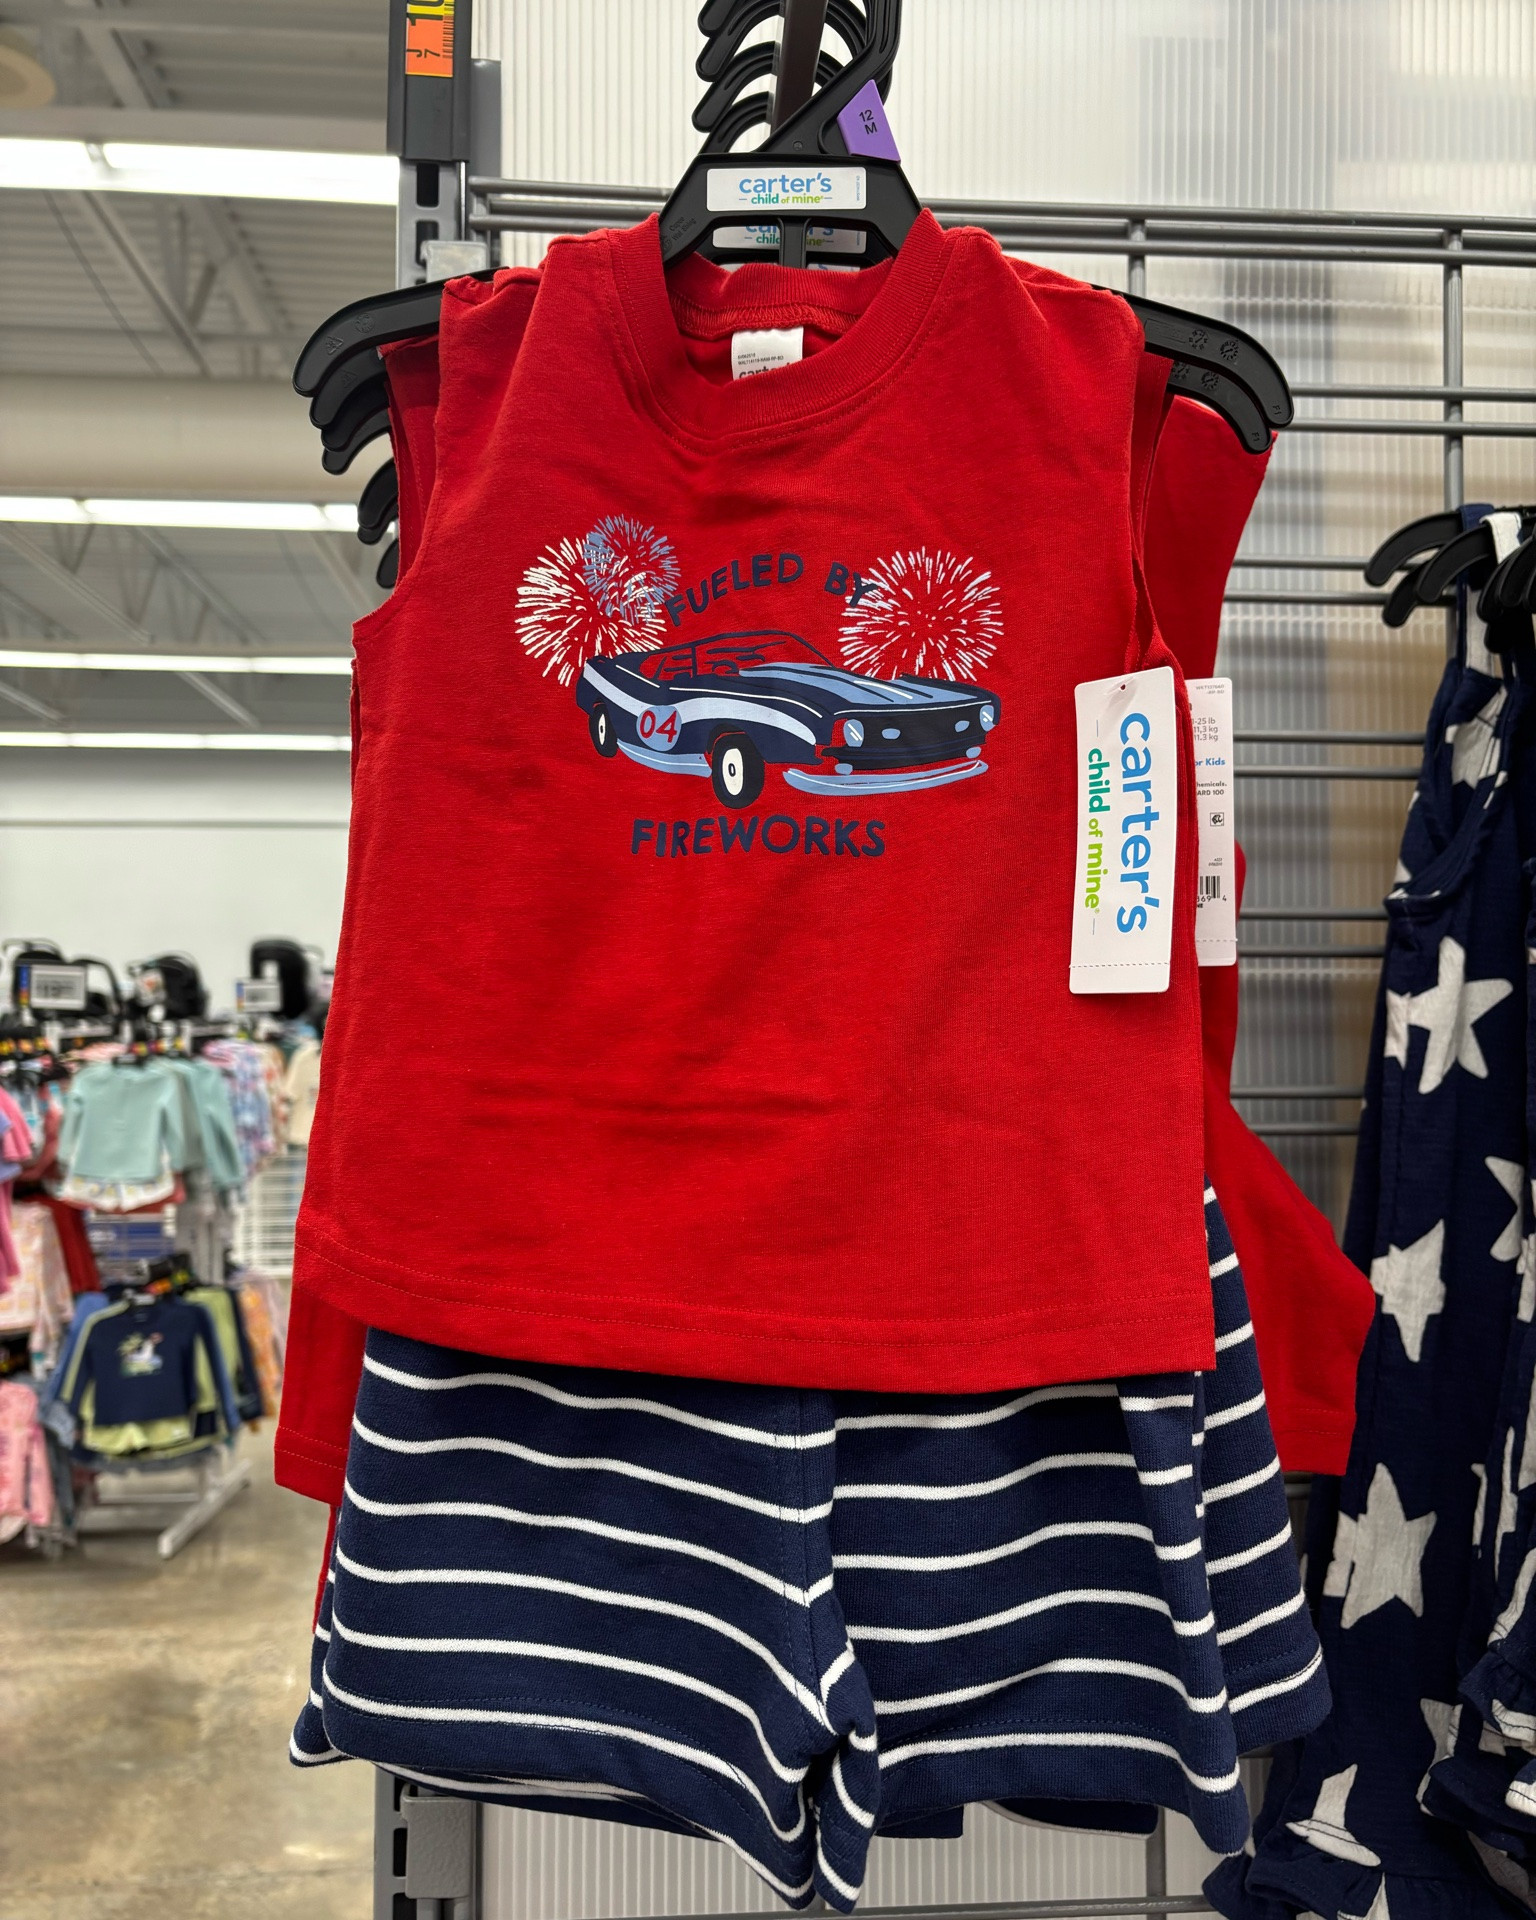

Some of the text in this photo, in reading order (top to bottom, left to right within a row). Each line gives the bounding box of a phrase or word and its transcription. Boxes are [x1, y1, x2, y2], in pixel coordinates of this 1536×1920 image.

[858, 109, 874, 122] 12
[864, 121, 878, 135] M
[739, 172, 832, 194] carter's
[750, 193, 779, 205] child
[780, 196, 791, 205] of
[664, 552, 879, 627] FUELED BY
[638, 708, 679, 744] 04
[1208, 717, 1216, 725] lb
[1208, 725, 1219, 733] kg
[1208, 733, 1219, 742] kg
[1205, 757, 1226, 766] Kids
[1087, 748, 1111, 814] child
[1087, 818, 1104, 838] of
[1116, 712, 1160, 934] carter's
[631, 814, 886, 858] FIREWORKS
[1222, 894, 1227, 902] 4
